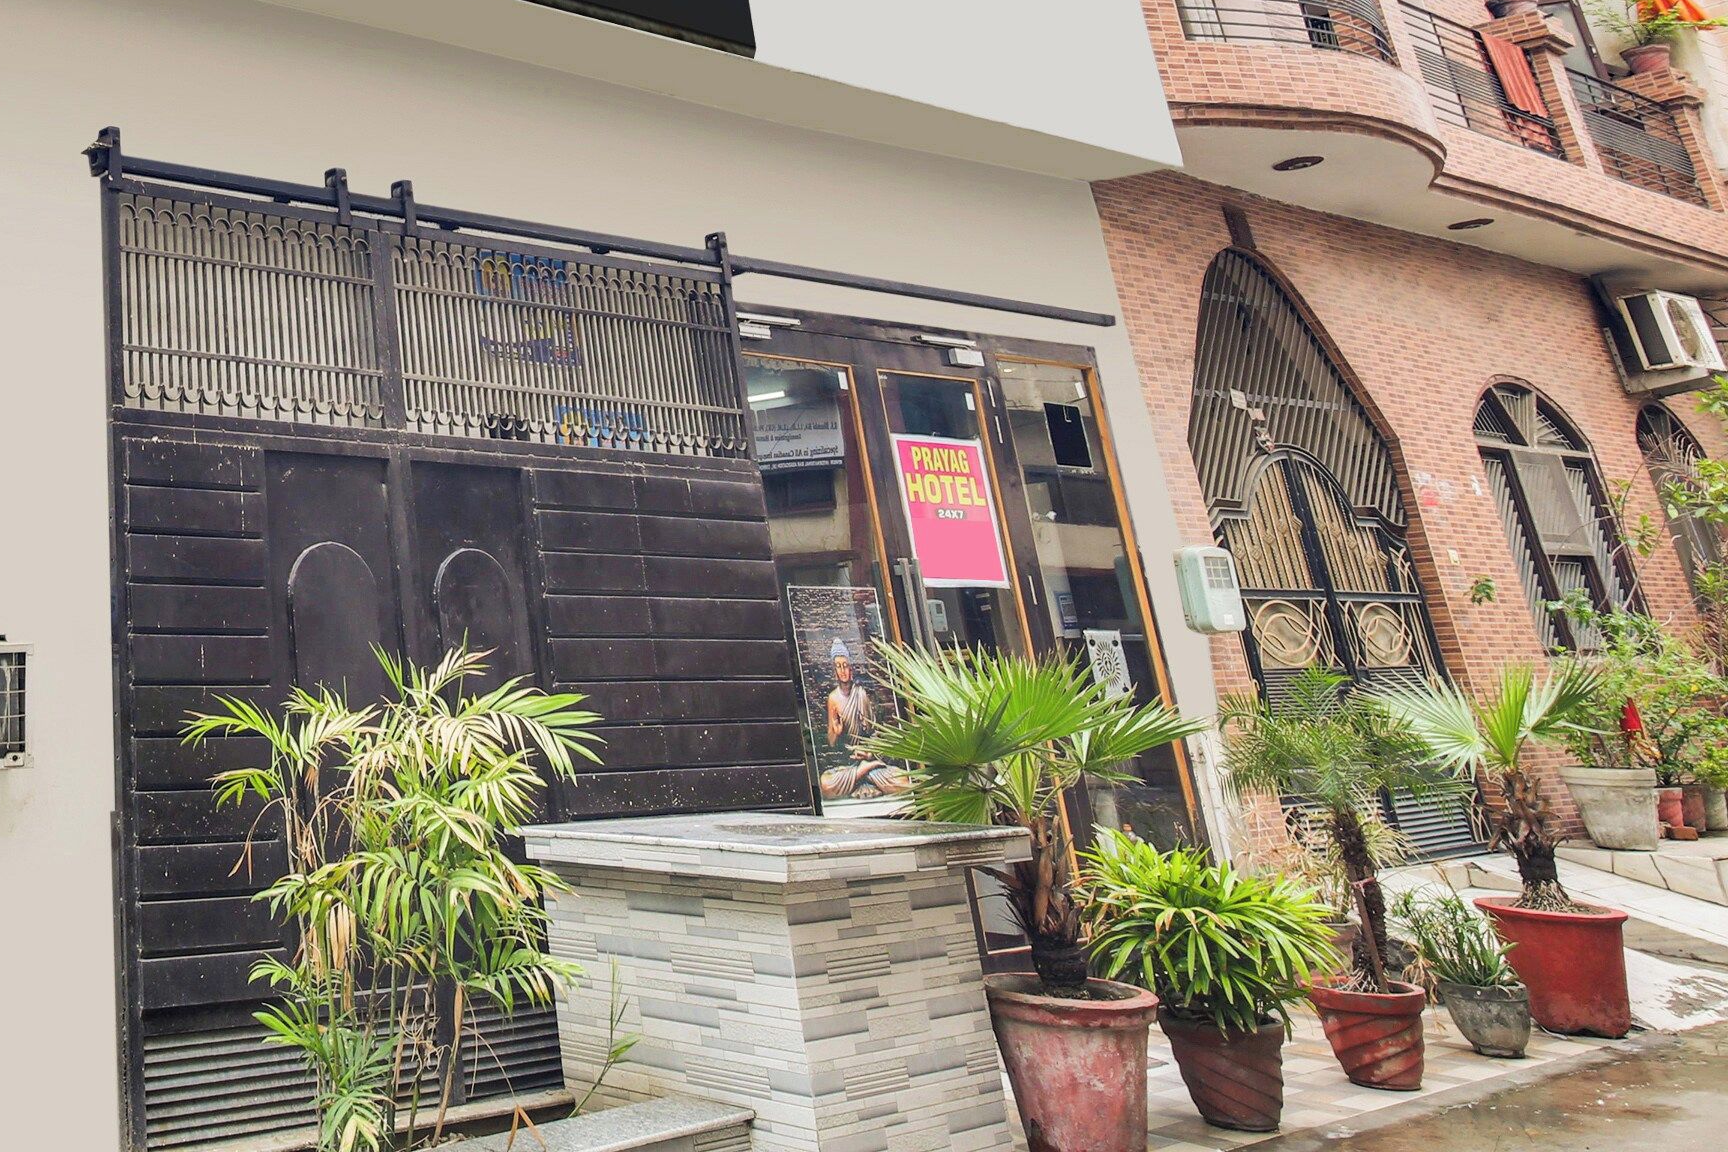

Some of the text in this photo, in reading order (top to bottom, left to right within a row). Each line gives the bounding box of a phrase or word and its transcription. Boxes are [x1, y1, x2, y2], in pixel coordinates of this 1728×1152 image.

[911, 446, 971, 474] PRAYAG
[905, 473, 987, 507] HOTEL
[937, 509, 965, 520] 24X7
